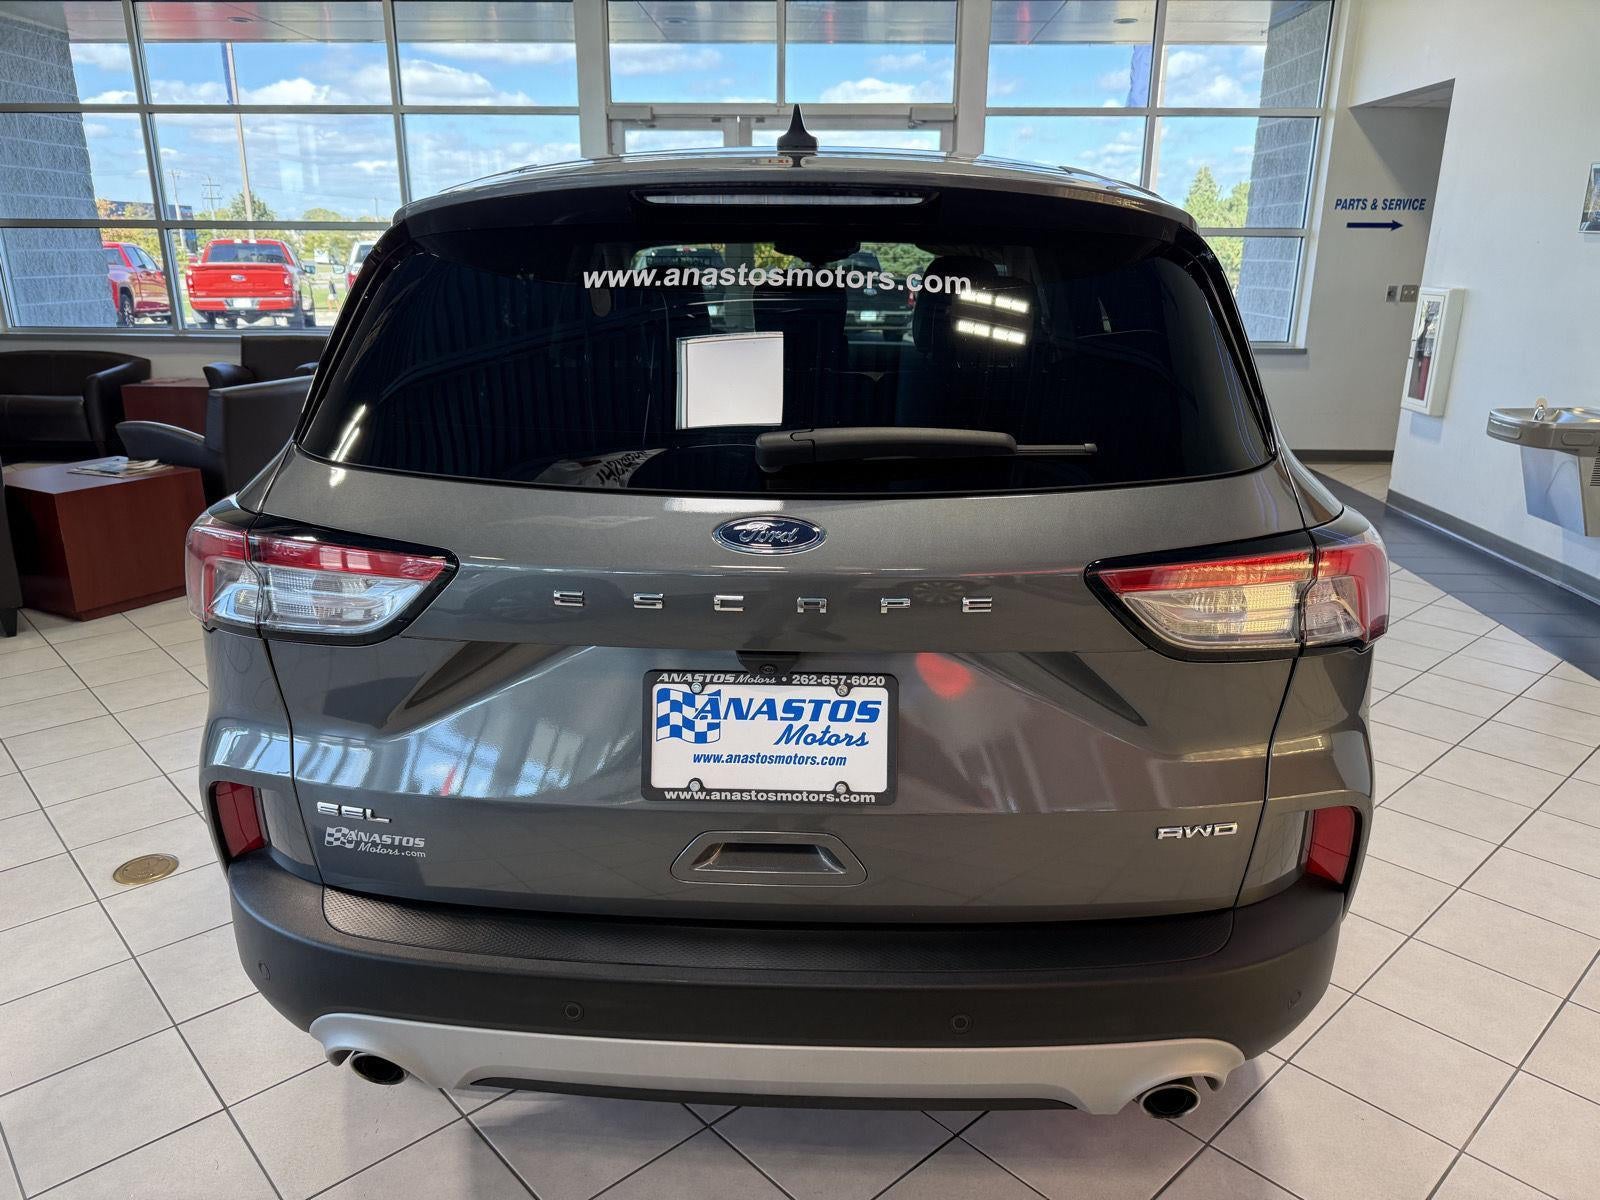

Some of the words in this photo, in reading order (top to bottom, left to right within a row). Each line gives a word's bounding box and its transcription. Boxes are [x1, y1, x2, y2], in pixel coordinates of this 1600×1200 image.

[1334, 198, 1368, 211] PARTS
[1370, 198, 1378, 211] &
[1381, 198, 1427, 211] SERVICE
[582, 262, 972, 295] www.anastosmotors.com
[733, 521, 799, 543] Ford
[553, 589, 993, 613] ESCAPE
[656, 673, 736, 684] ANASTOS
[735, 674, 777, 685] Motors
[791, 674, 886, 686] 262-657-6020
[692, 696, 882, 724] ANASTOS
[773, 723, 870, 747] Motors
[692, 752, 847, 767] www.anastosmotors.com
[664, 789, 876, 804] www.anastosmotors.com
[316, 801, 392, 824] SEL
[345, 829, 426, 848] ANASTOS
[1157, 822, 1239, 840] AWD
